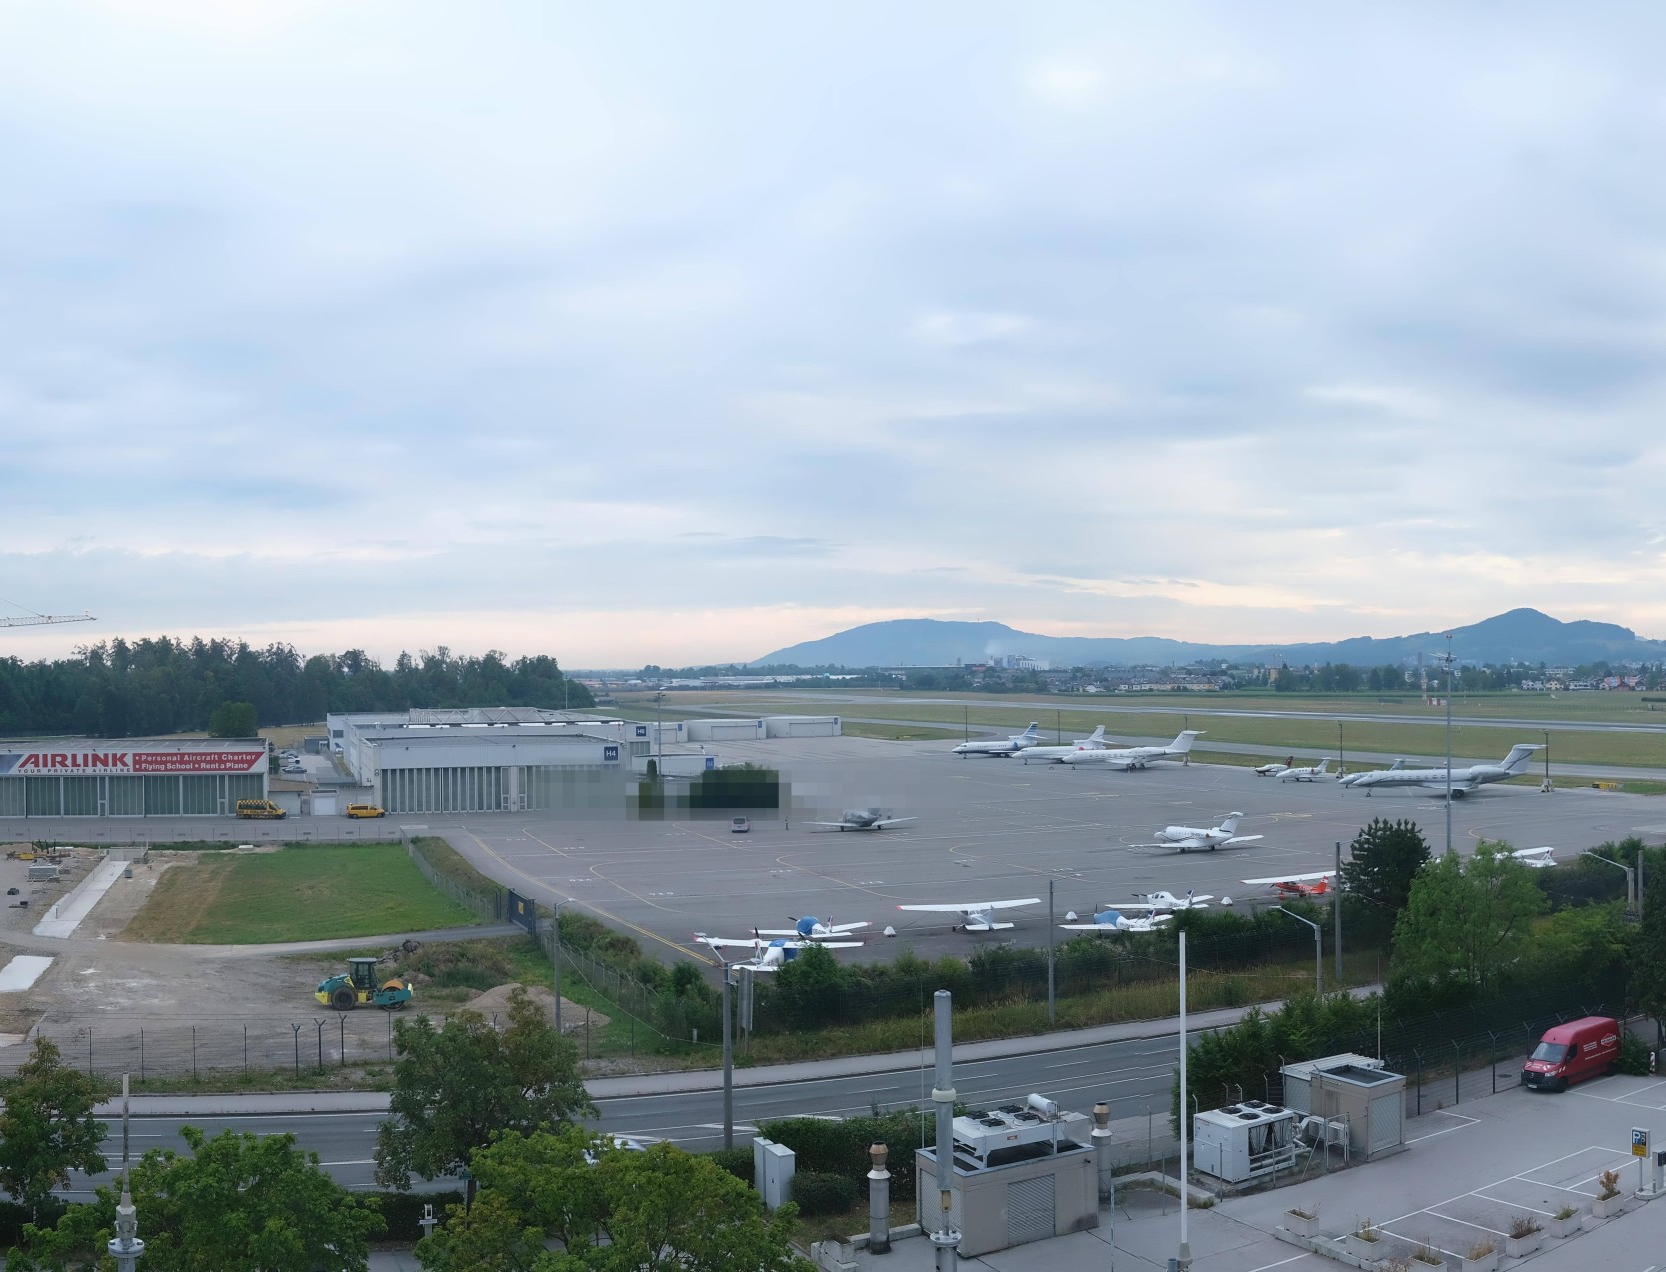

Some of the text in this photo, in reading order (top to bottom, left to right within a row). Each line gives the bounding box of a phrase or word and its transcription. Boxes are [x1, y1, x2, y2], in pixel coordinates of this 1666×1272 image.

[141, 754, 180, 762] Personal
[221, 753, 256, 761] Charter
[605, 749, 616, 757] H4
[18, 752, 130, 768] AIRLINK
[141, 763, 165, 771] Flying
[166, 762, 193, 770] School
